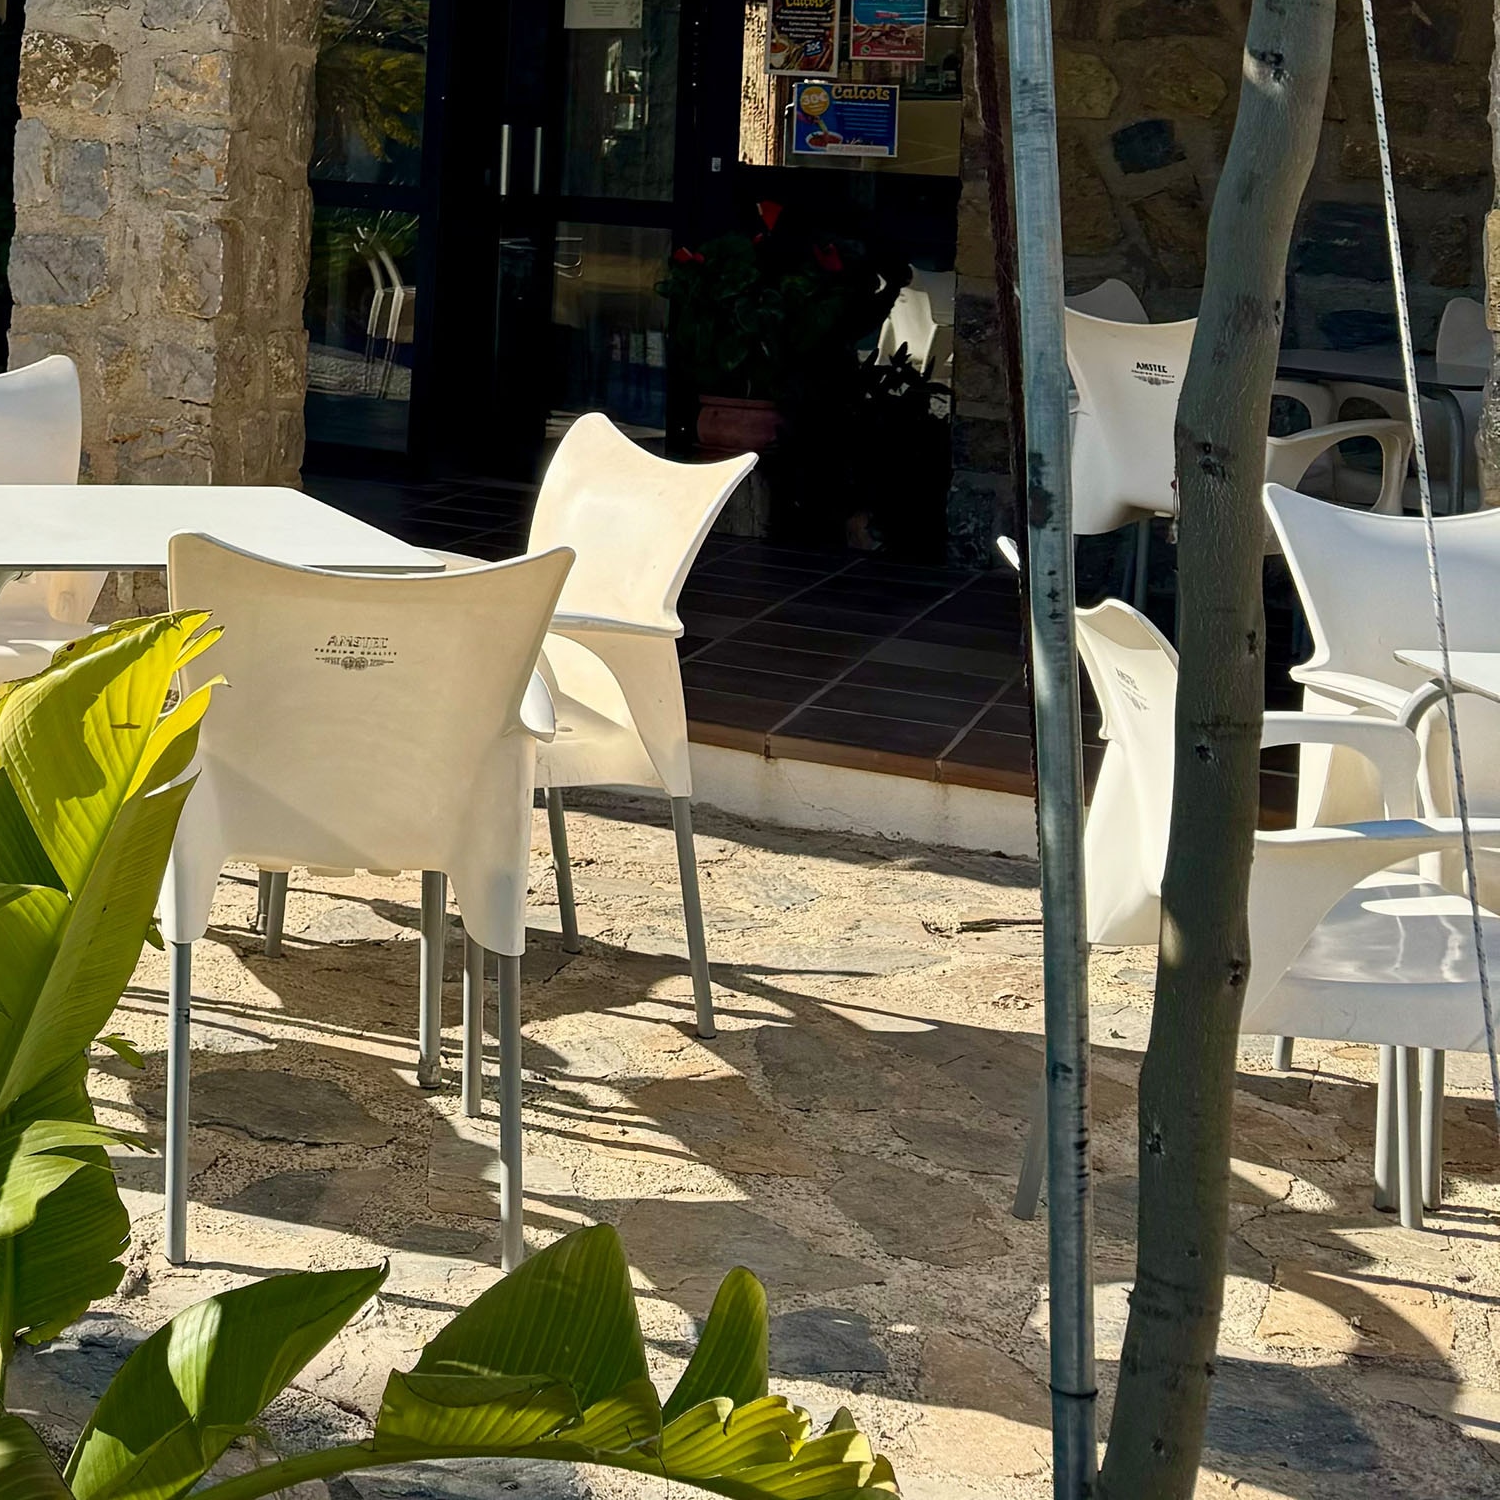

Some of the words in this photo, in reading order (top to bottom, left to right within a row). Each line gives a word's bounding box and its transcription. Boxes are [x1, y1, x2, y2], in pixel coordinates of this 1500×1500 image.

[831, 85, 891, 102] Calçots
[1136, 362, 1168, 373] AMSTEL
[327, 635, 389, 648] AMSTEL
